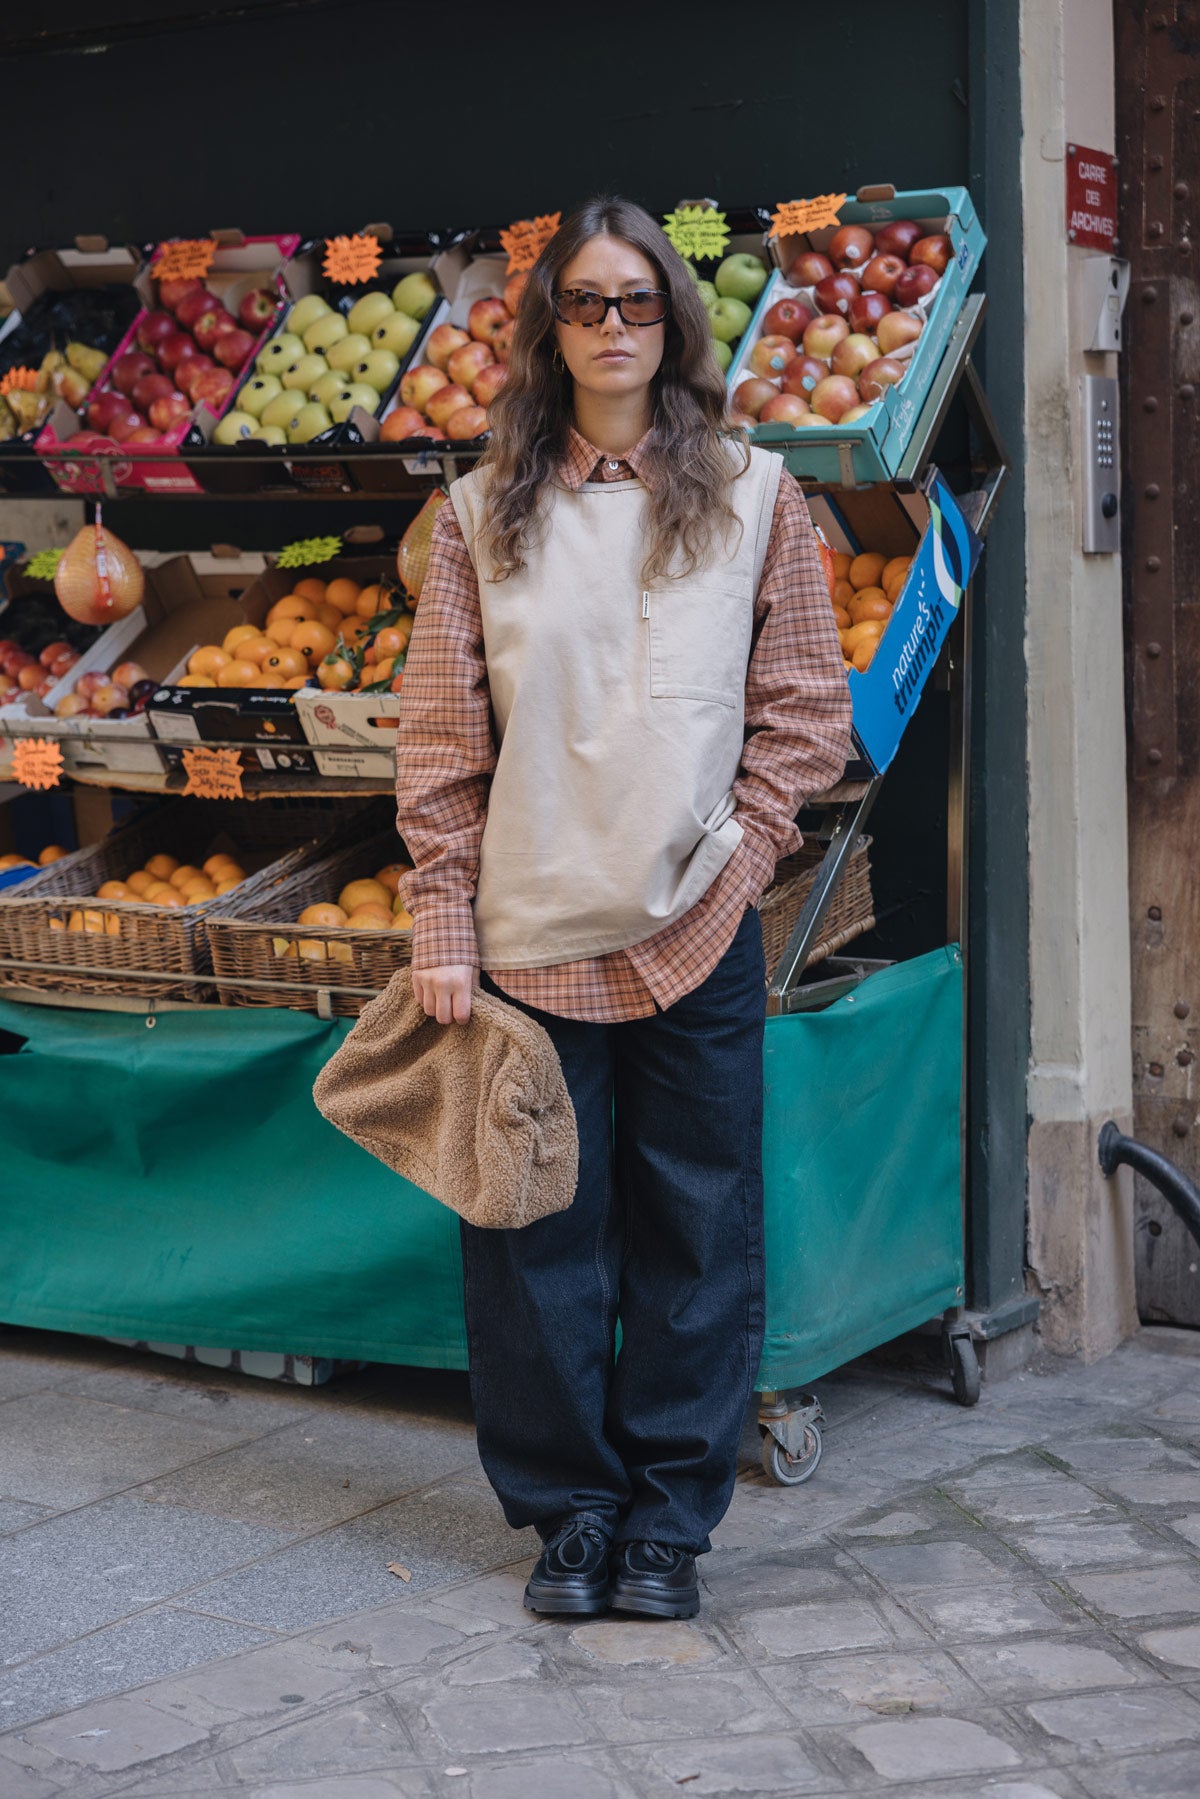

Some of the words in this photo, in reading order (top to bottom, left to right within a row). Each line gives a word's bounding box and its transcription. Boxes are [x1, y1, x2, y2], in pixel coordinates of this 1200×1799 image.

[1078, 161, 1107, 184] CARRE
[1085, 188, 1101, 206] DES
[1070, 210, 1114, 236] ARCHIVES
[891, 600, 931, 689] nature's
[893, 602, 945, 716] triumph
